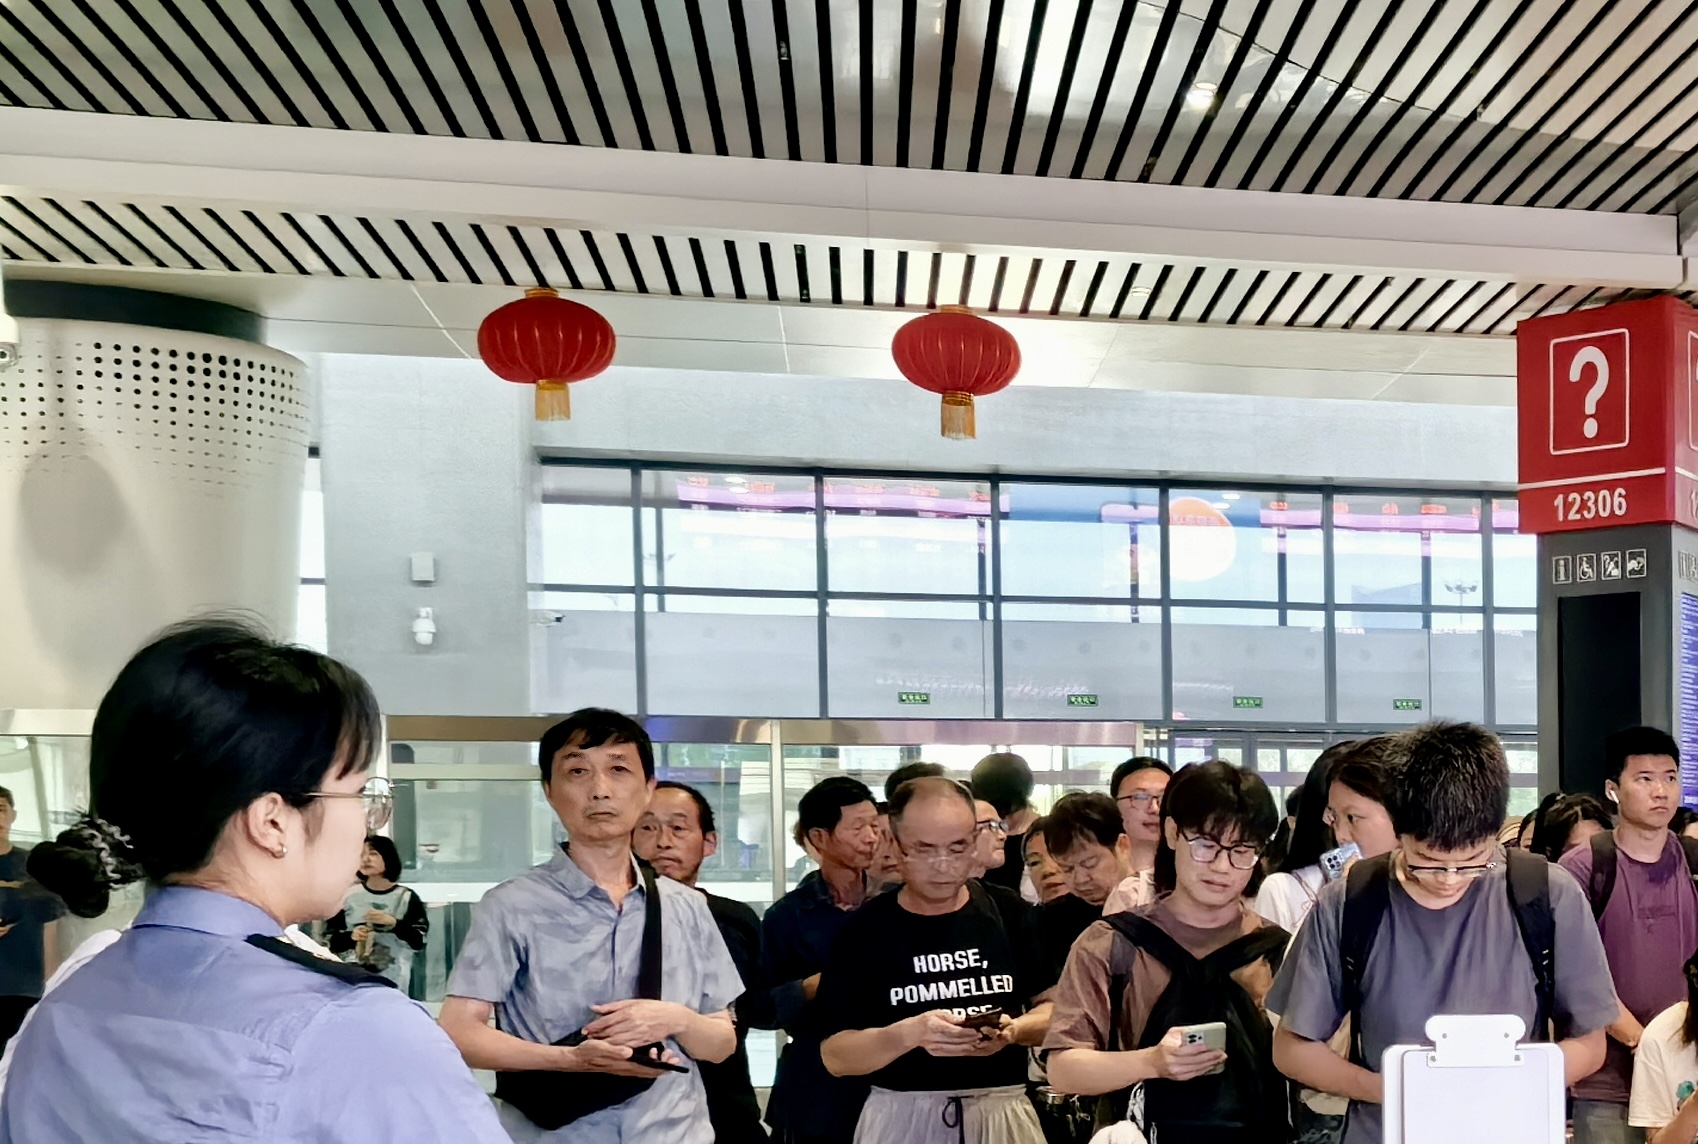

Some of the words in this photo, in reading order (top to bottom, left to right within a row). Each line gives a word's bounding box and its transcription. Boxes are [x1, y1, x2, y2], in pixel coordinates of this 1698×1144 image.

[1554, 487, 1628, 522] 12306
[913, 949, 989, 974] HORSE,
[890, 974, 1013, 1006] POMMELLED
